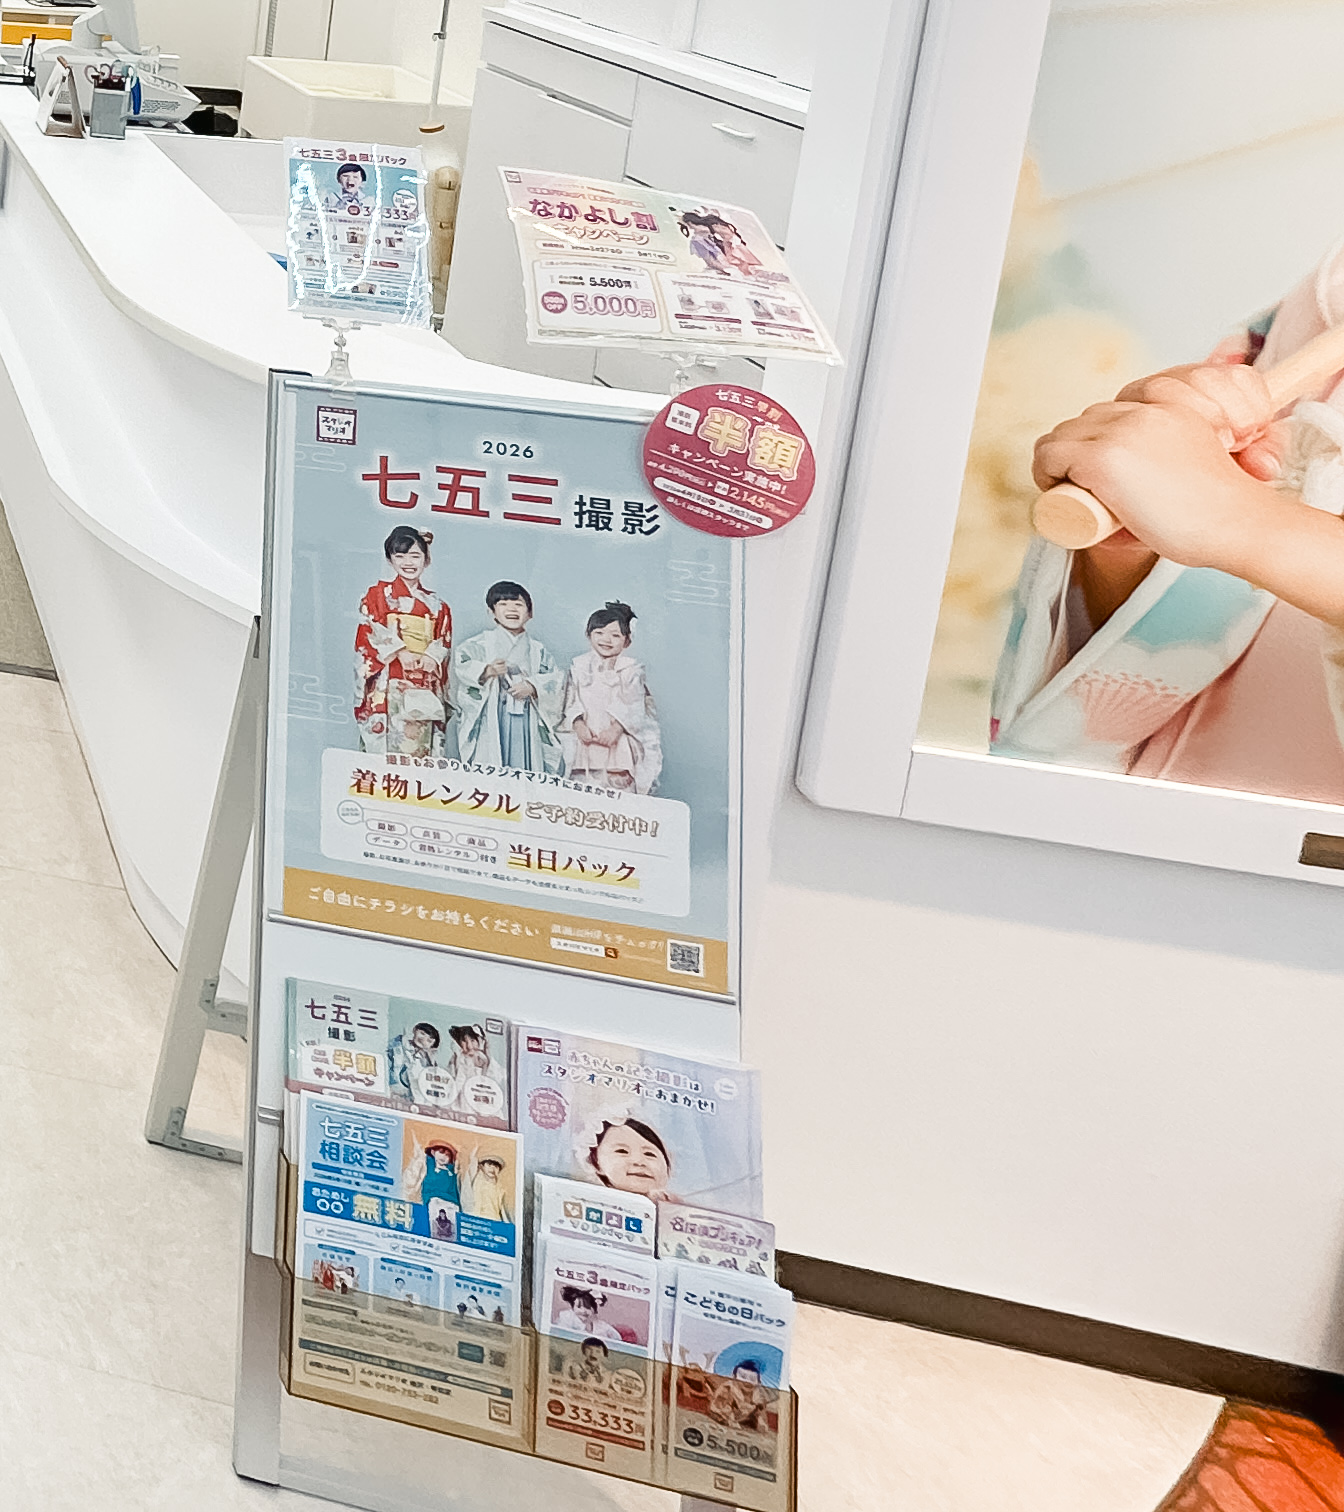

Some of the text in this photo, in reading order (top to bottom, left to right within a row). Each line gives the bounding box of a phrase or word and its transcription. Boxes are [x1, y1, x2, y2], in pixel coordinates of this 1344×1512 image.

[528, 198, 659, 232] なかよし割
[571, 292, 657, 319] 5,000円
[482, 440, 534, 459] 2026
[697, 406, 805, 482] 半額
[350, 768, 521, 815] 着物レンタル
[507, 843, 636, 882] 当日パック
[304, 997, 379, 1030] 七五三
[319, 1116, 389, 1148] 七五三
[318, 1139, 389, 1173] 相談会
[352, 1194, 413, 1229] 無料
